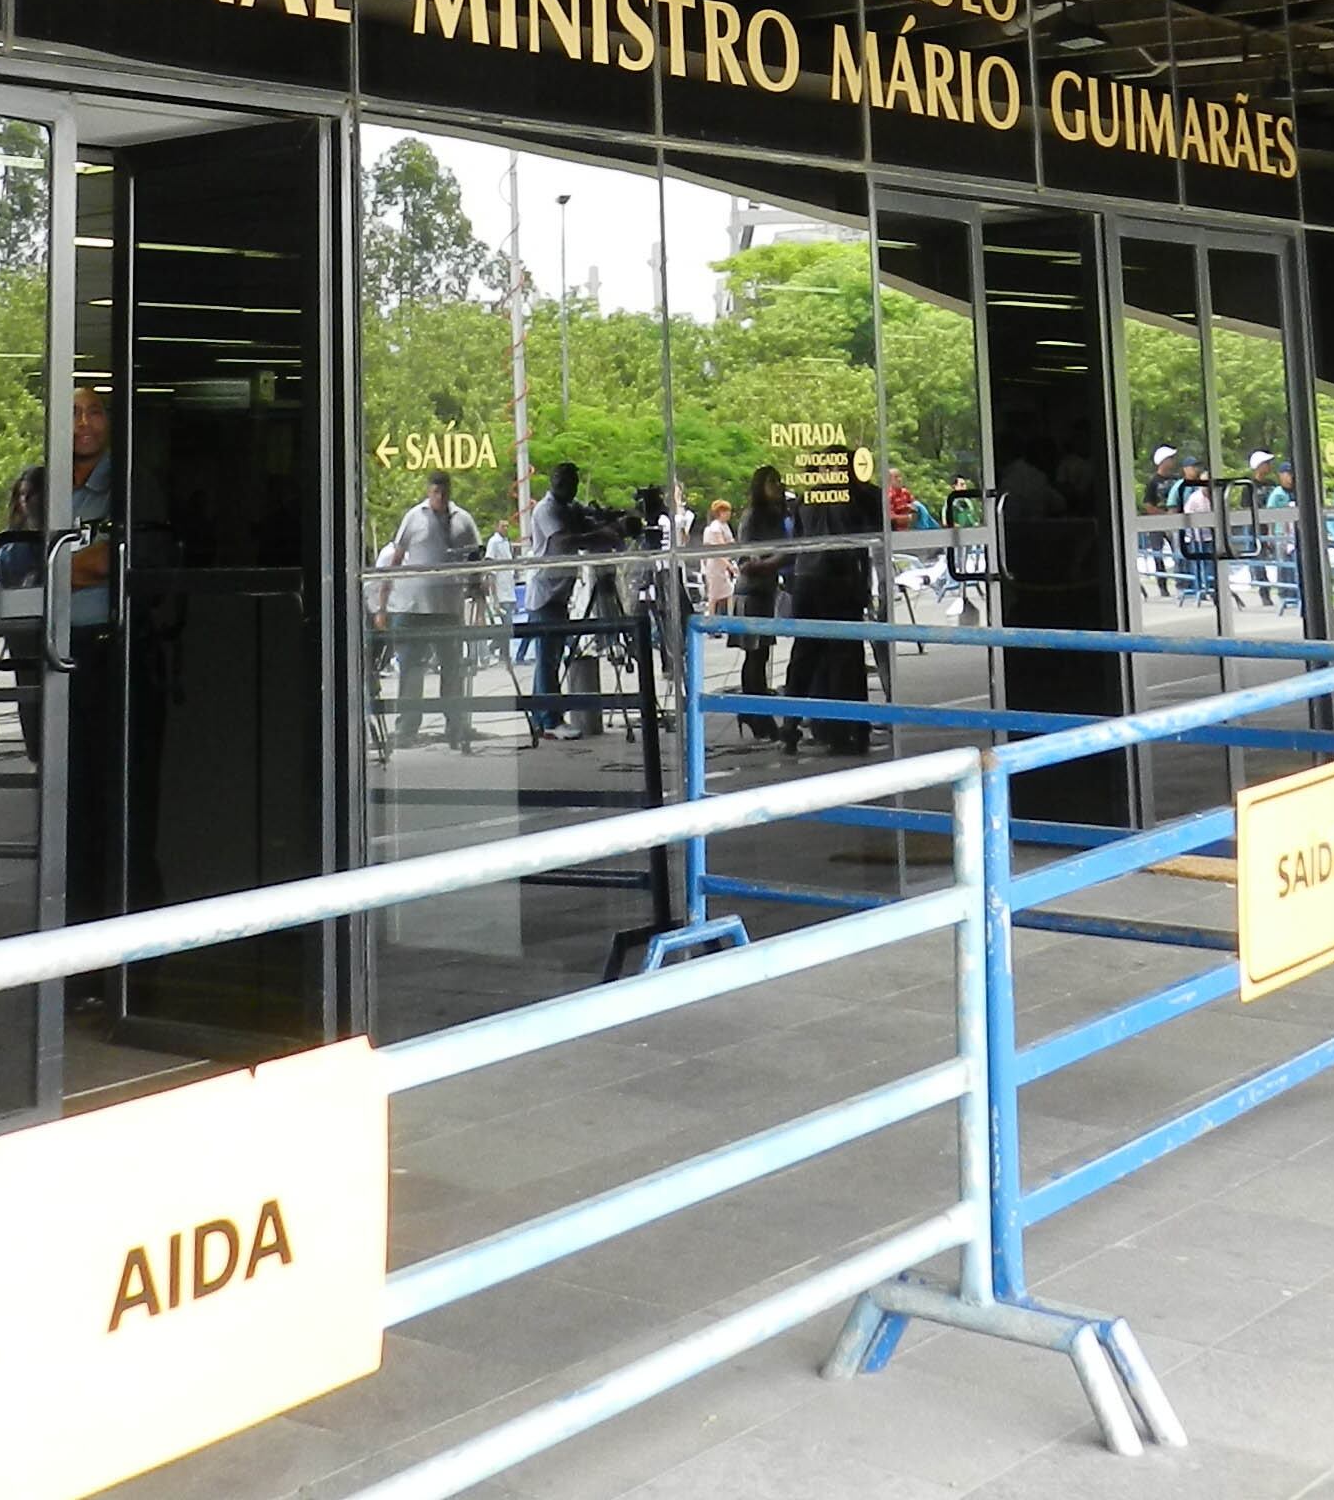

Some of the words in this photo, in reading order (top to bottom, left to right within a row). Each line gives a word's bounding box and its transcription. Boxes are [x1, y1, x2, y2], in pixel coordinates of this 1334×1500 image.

[831, 14, 1020, 130] MÁRIO
[1050, 70, 1298, 179] GUIMARÃES
[405, 419, 498, 470] SAÍDA
[770, 422, 847, 447] ENTRADA
[794, 452, 849, 466] ADVOGADOS
[106, 1198, 294, 1334] AIDA
